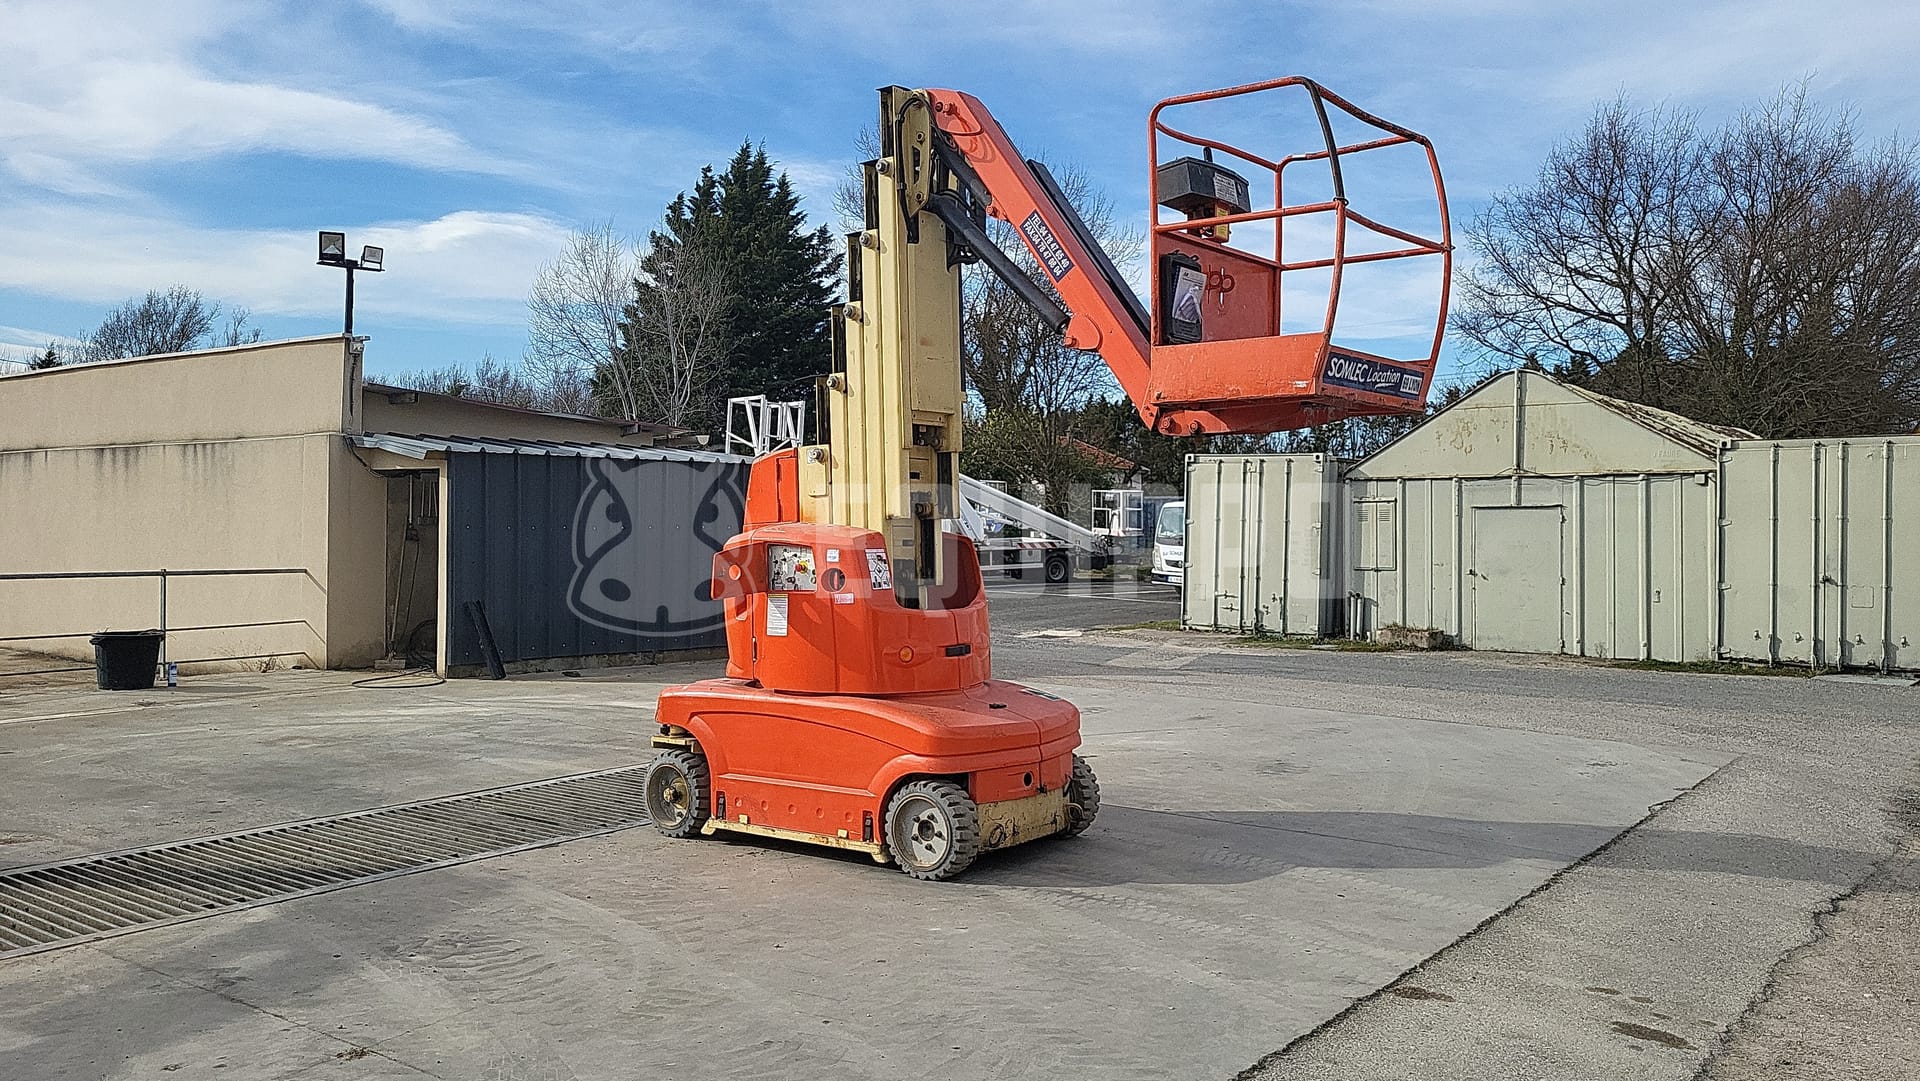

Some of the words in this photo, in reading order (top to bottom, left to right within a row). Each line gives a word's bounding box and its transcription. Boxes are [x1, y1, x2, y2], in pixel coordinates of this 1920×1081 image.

[1050, 242, 1058, 251] 47
[1043, 250, 1051, 260] 47
[1327, 357, 1368, 383] SOMLEC
[1366, 367, 1401, 383] Location
